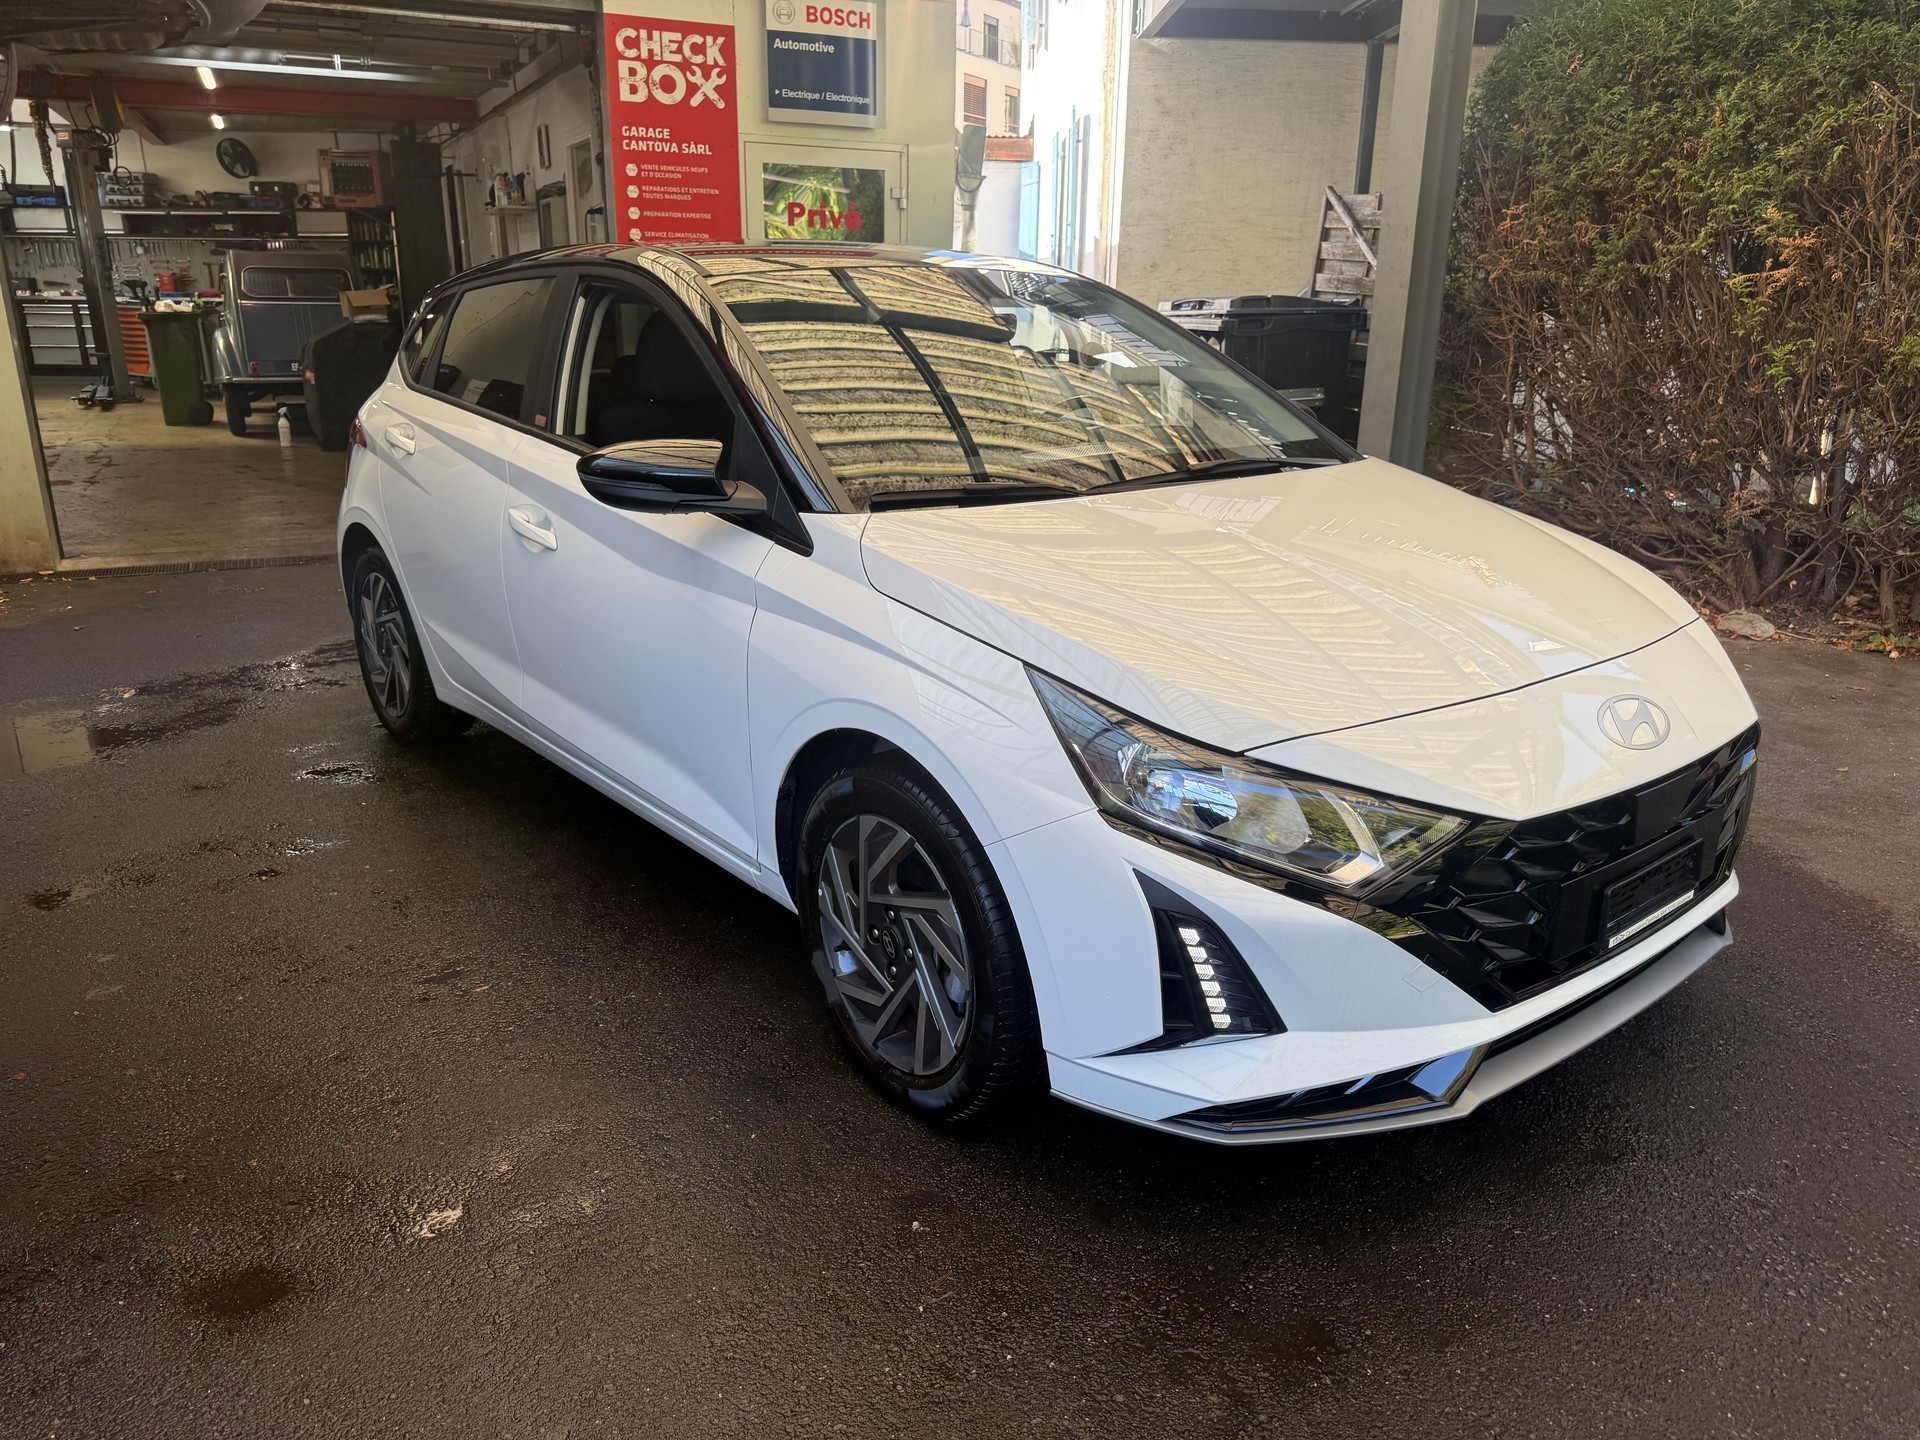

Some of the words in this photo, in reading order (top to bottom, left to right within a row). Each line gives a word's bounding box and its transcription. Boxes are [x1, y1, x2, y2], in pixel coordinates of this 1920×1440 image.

[806, 5, 871, 30] BOSCH
[615, 27, 727, 67] CHECK
[773, 38, 835, 54] Automotive
[782, 88, 820, 101] Electrique
[826, 92, 872, 105] Electronique
[621, 125, 671, 139] GARAGE
[622, 139, 679, 153] CANTOVA
[690, 166, 709, 174] NEUFS
[682, 212, 712, 220] EXPERTISE
[787, 201, 862, 231] Privé
[668, 231, 710, 239] CLIMATISATION
